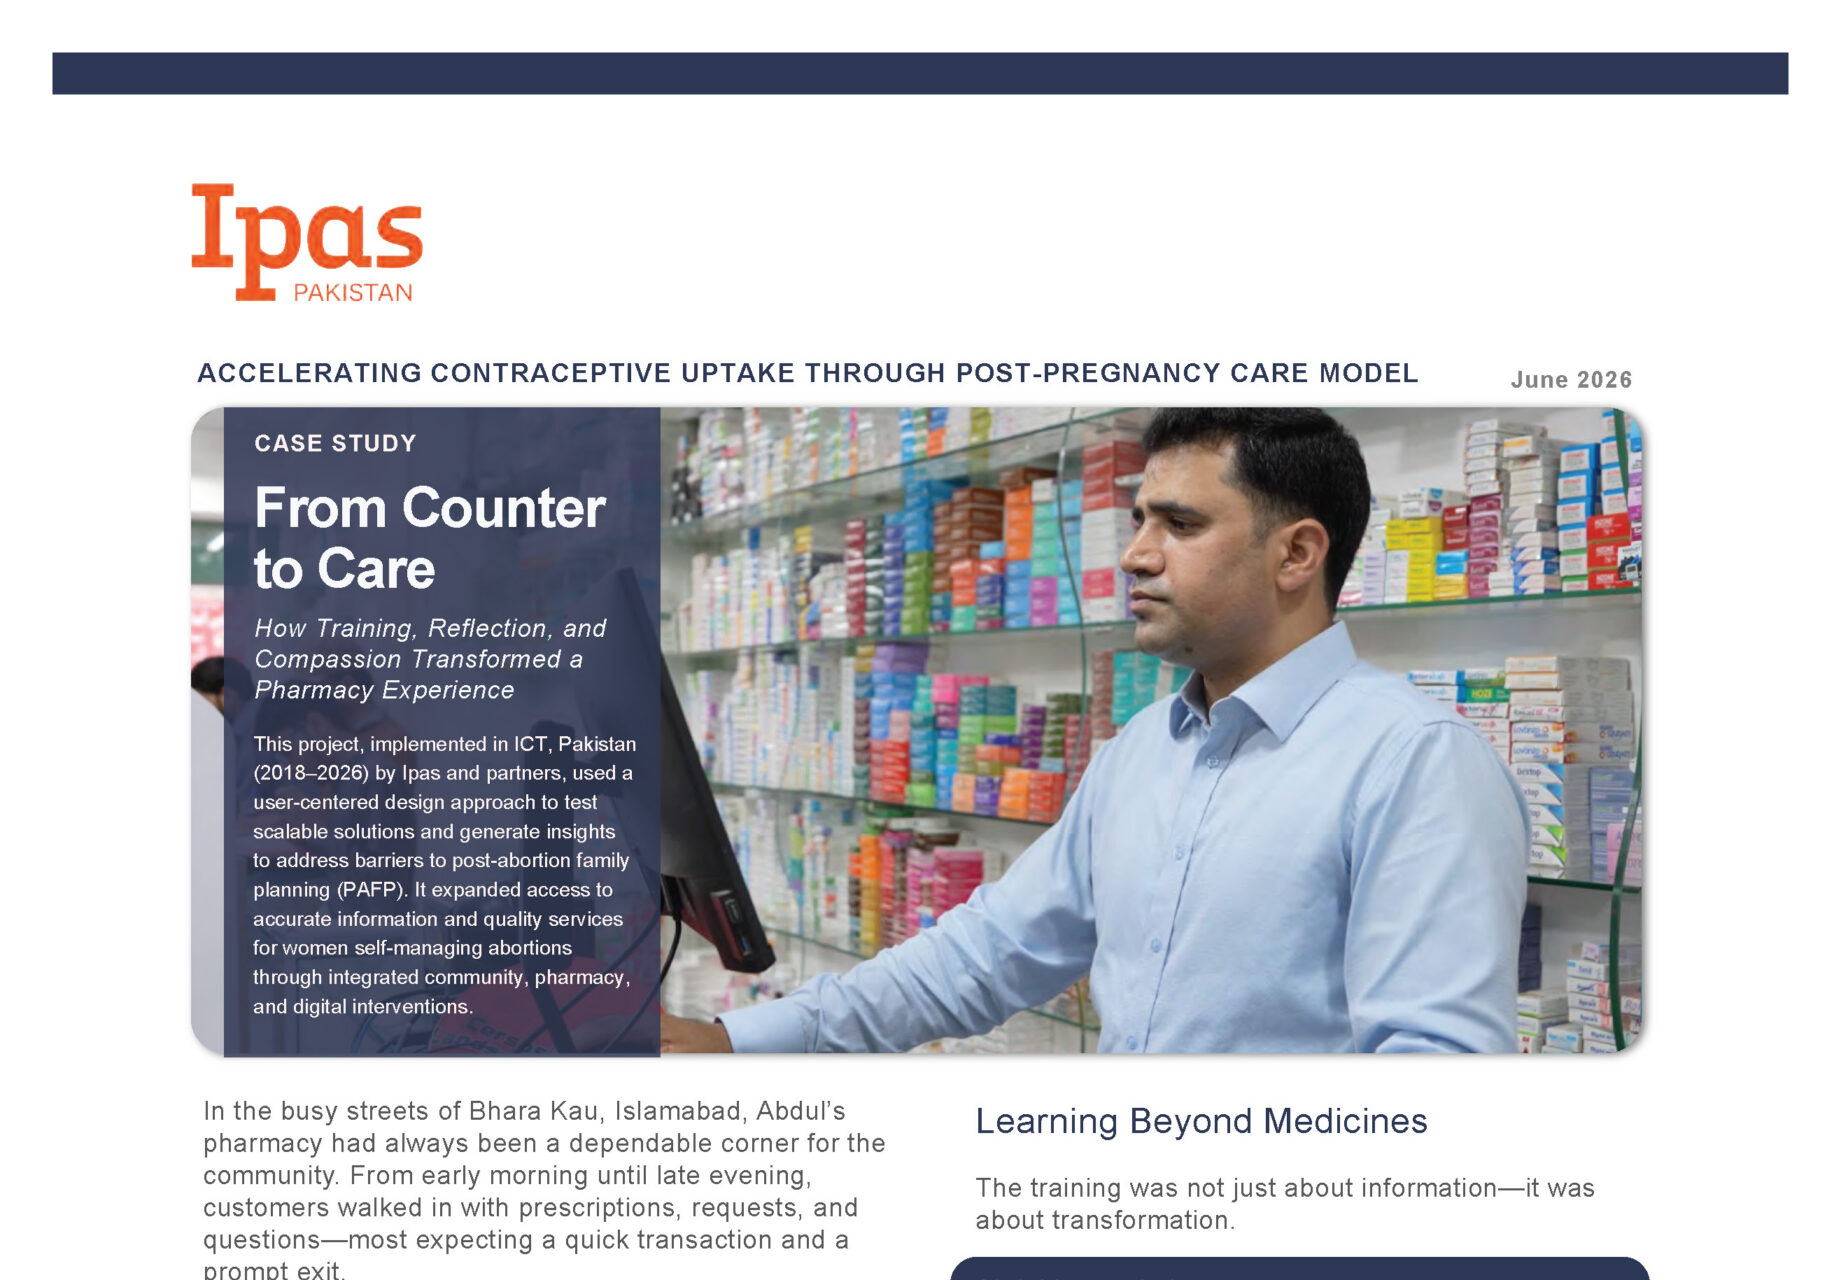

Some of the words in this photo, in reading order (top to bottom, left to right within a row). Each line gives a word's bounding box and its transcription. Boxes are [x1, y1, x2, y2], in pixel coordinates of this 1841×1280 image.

[191, 182, 424, 302] Ipas
[294, 283, 413, 302] PAKISTAN
[196, 362, 421, 383] ACCELERATING
[430, 362, 671, 383] CONTRACEPTIVE
[682, 362, 795, 383] UPTAKE
[804, 362, 945, 383] THROUGH
[957, 362, 1221, 383] POST-PREGNANCY
[1230, 362, 1308, 383] CARE
[1320, 362, 1419, 383] MODEL
[1510, 370, 1568, 389] June
[1577, 370, 1632, 389] 2026
[254, 433, 322, 453] CASE
[331, 433, 417, 452] STUDY
[256, 485, 386, 529] From
[403, 485, 608, 529] Counter
[253, 547, 303, 590] to
[318, 545, 436, 590] Care
[254, 618, 307, 638] How
[317, 618, 417, 643] Training,
[428, 618, 552, 641] Reflection,
[563, 618, 608, 638] and
[255, 648, 401, 674] Compassion
[412, 648, 562, 669] Transformed
[569, 653, 583, 669] a
[254, 679, 375, 704] Pharmacy
[382, 679, 515, 704] Experience
[253, 735, 293, 752] This
[298, 735, 364, 756] project,
[370, 735, 487, 756] implemented
[493, 735, 508, 752] in
[515, 735, 552, 755] ICT,
[559, 735, 636, 752] Pakistan
[375, 764, 396, 785] by
[403, 764, 441, 785] Ipas
[446, 764, 480, 781] and
[487, 765, 566, 785] partners,
[573, 764, 616, 781] used
[622, 768, 633, 781] a
[254, 881, 330, 902] planning
[337, 881, 409, 902] (PAFP).
[415, 881, 426, 898] It
[431, 881, 521, 902] expanded
[527, 885, 591, 898] access
[595, 882, 613, 898] to
[253, 998, 287, 1014] and
[293, 998, 347, 1019] digital
[352, 998, 473, 1014] interventions.
[205, 1100, 224, 1121] In
[233, 1100, 272, 1121] the
[281, 1100, 339, 1126] busy
[347, 1100, 429, 1121] streets
[438, 1100, 462, 1121] of
[470, 1100, 541, 1121] Bhara
[551, 1100, 604, 1125] Kau,
[616, 1100, 747, 1125] Islamabad,
[977, 1107, 1117, 1141] Learning
[1131, 1107, 1252, 1141] Beyond
[1265, 1107, 1428, 1134] Medicines
[416, 1228, 532, 1255] expecting
[542, 1233, 556, 1250] a
[565, 1228, 630, 1255] quick
[636, 1228, 772, 1250] transaction
[781, 1228, 825, 1250] and
[835, 1233, 849, 1250] a
